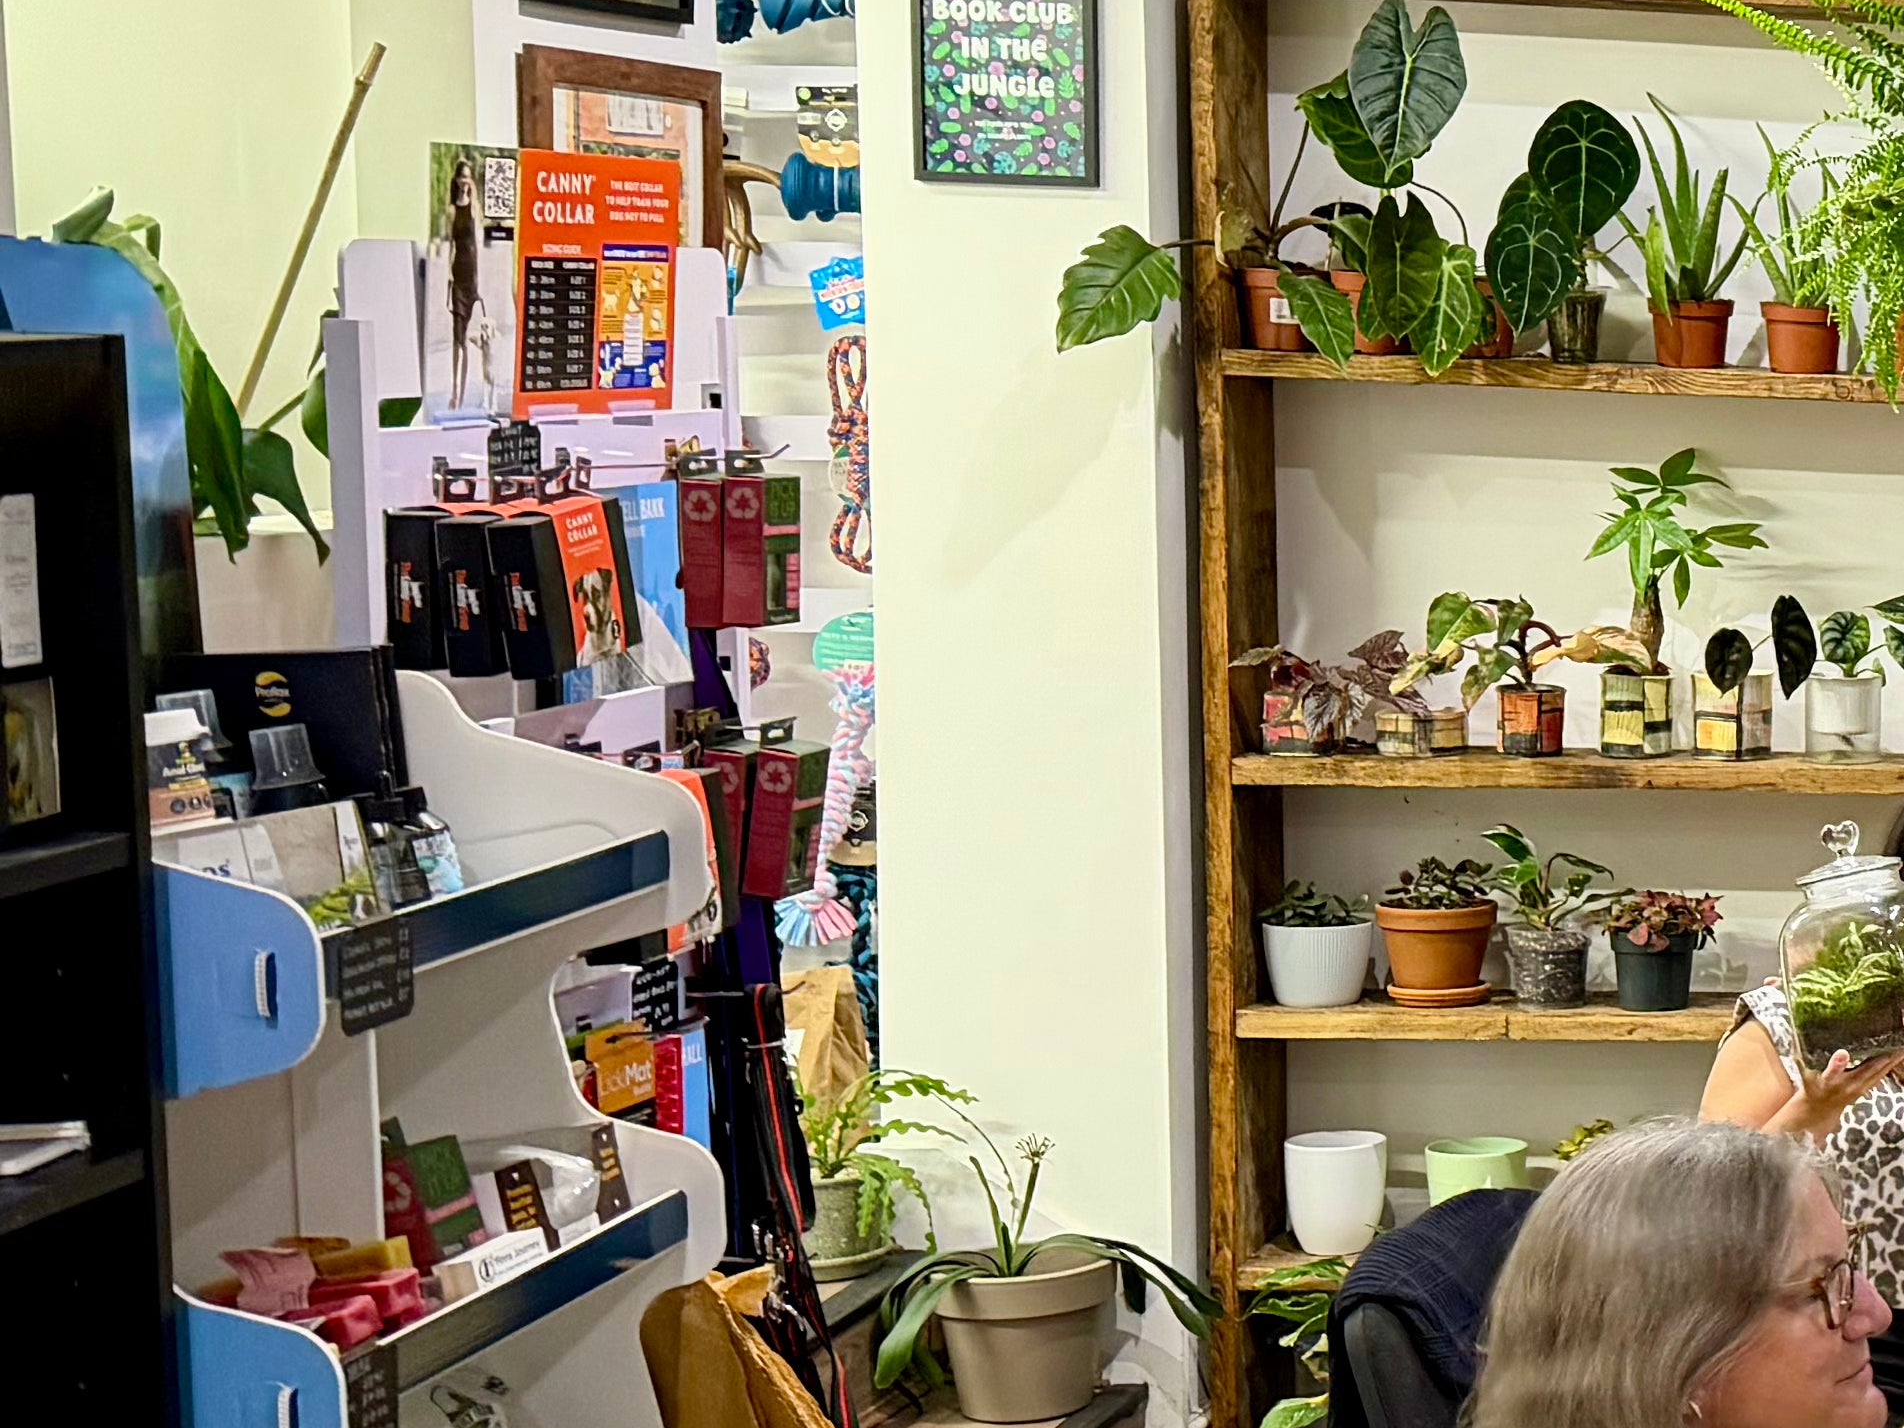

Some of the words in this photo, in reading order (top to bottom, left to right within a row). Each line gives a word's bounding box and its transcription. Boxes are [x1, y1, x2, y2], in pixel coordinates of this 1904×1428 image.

[1008, 0, 1075, 25] CLUB
[961, 36, 990, 60] IN
[536, 171, 594, 196] CANNY
[533, 201, 596, 224] COLLAR
[567, 524, 598, 543] COLLAR
